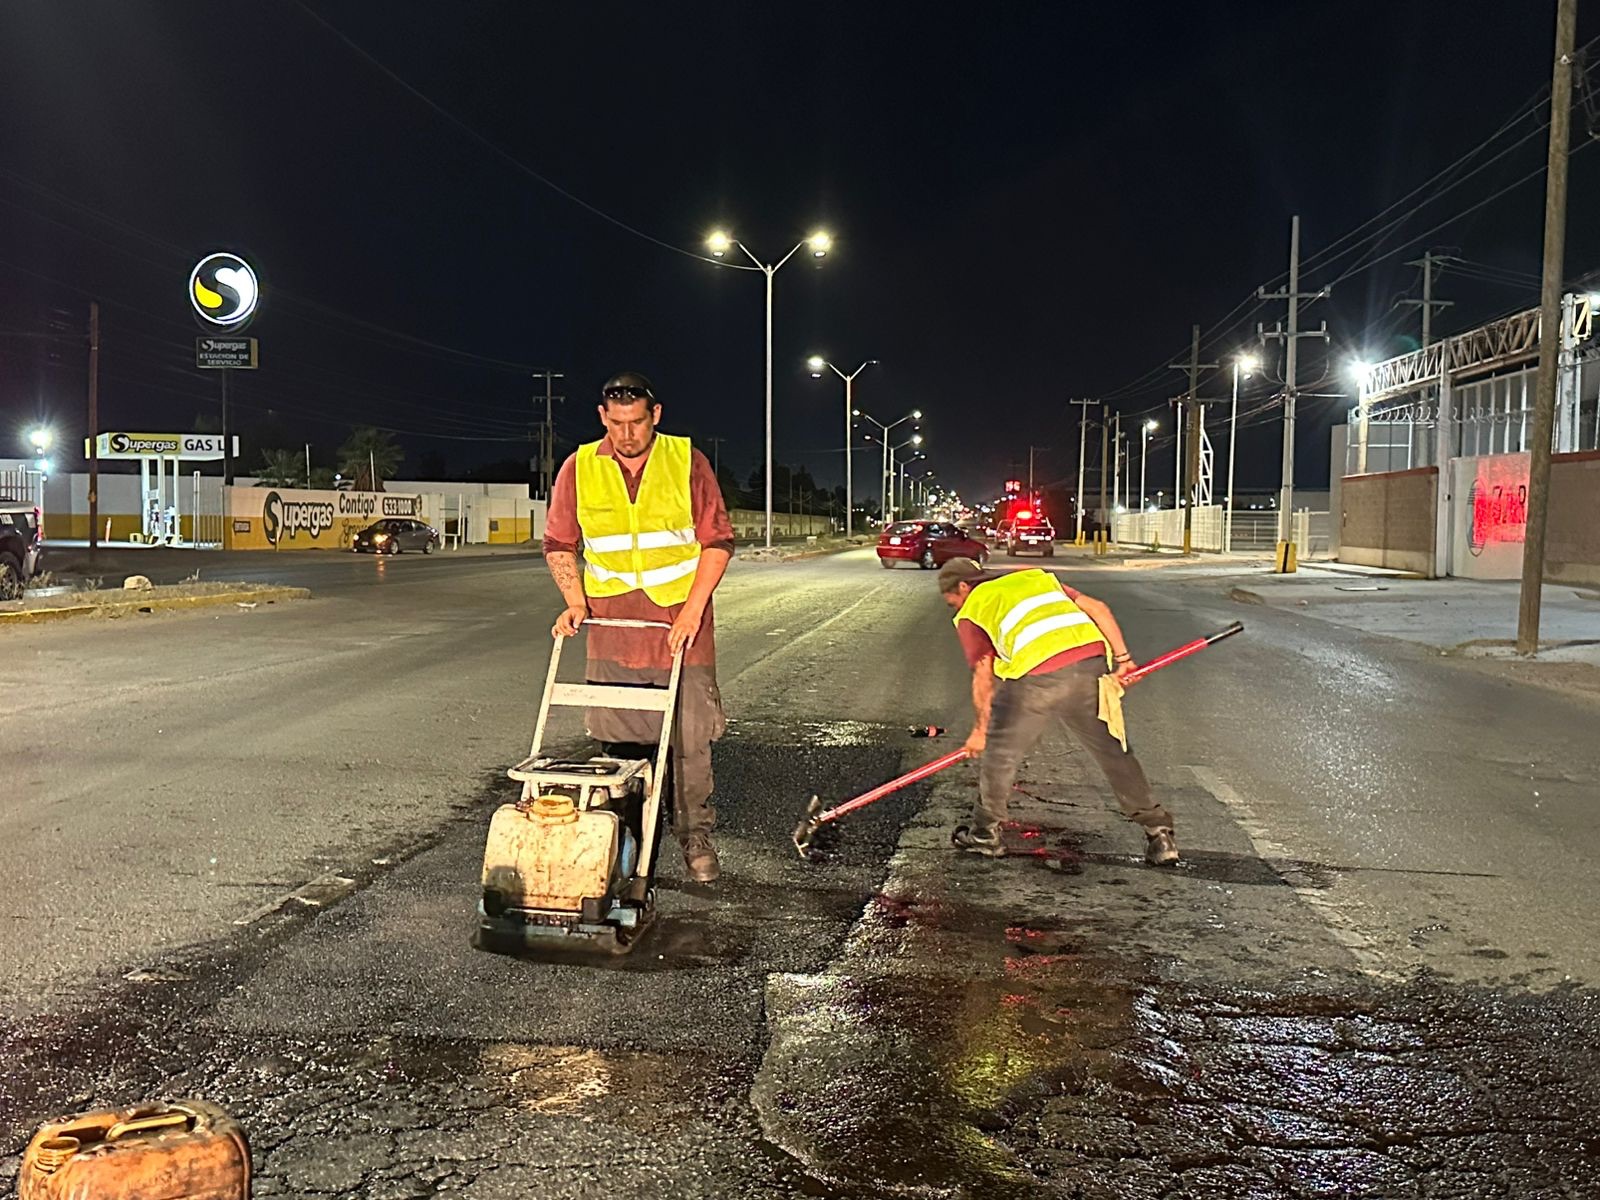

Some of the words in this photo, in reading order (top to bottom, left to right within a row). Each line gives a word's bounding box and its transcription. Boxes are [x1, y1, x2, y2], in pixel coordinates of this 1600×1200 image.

[201, 340, 247, 351] Supergas
[110, 433, 178, 453] Supergas
[184, 439, 213, 451] GAS
[263, 491, 334, 546] Supergas
